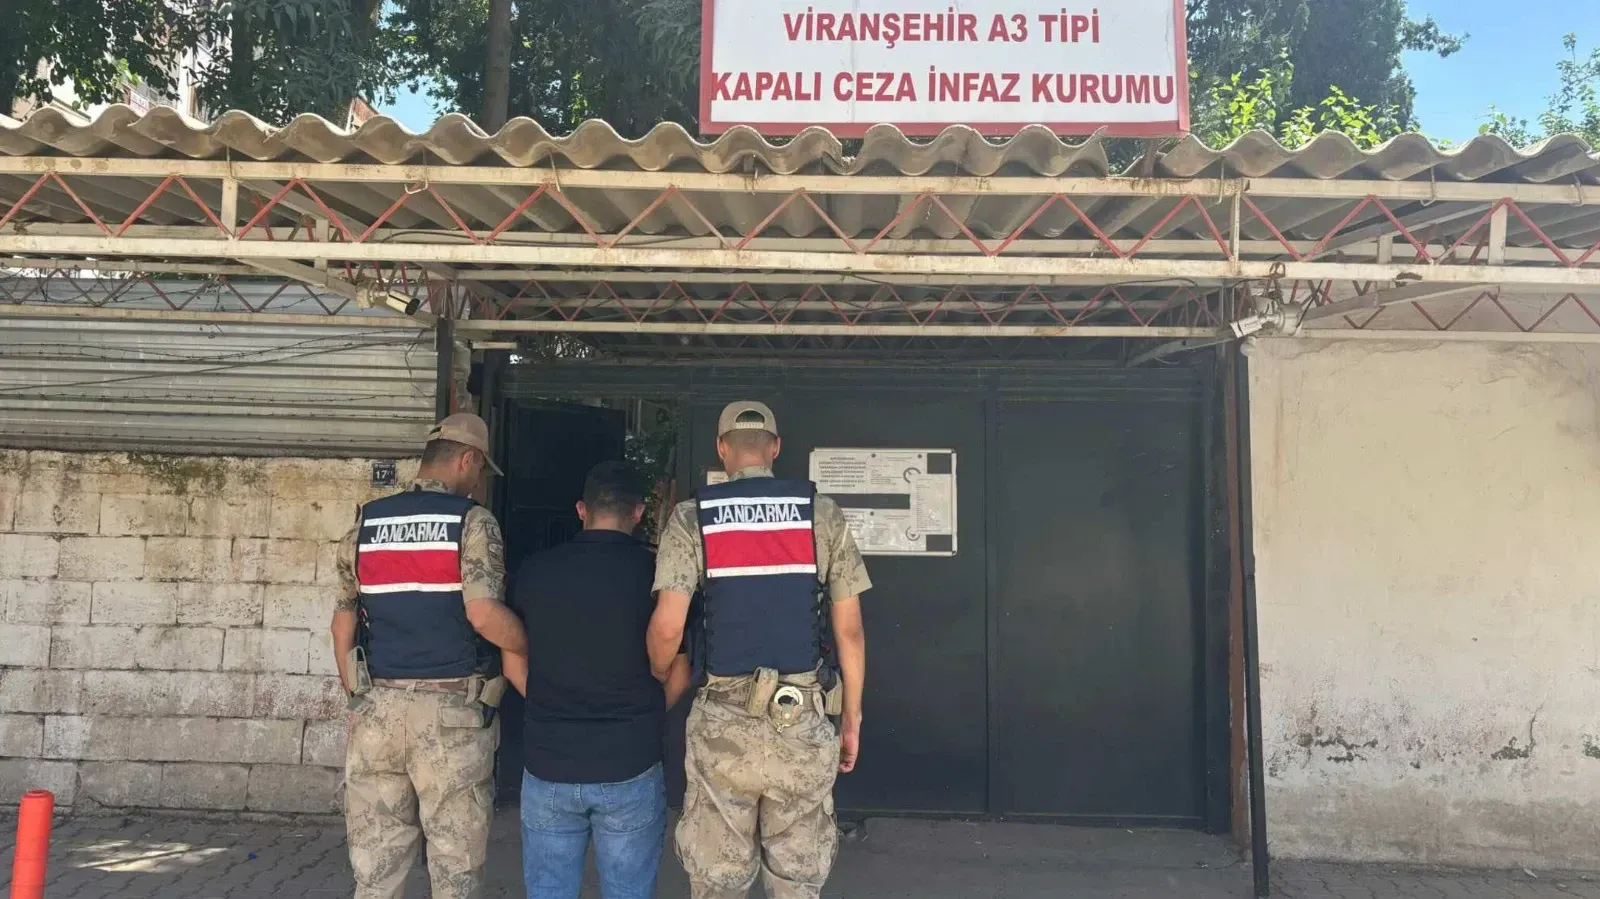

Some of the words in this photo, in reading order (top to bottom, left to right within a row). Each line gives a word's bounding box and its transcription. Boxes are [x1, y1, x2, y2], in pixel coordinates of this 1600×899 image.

[783, 6, 978, 49] VİRANŞEHİR
[988, 14, 1028, 43] A3
[1038, 8, 1100, 43] TİPİ
[712, 72, 822, 101] KAPALI
[833, 72, 917, 102] CEZA
[928, 65, 1020, 103] İNFAZ
[1032, 73, 1174, 104] KURUMU
[713, 503, 801, 524] JANDARMA
[371, 521, 449, 544] JANDARMA
